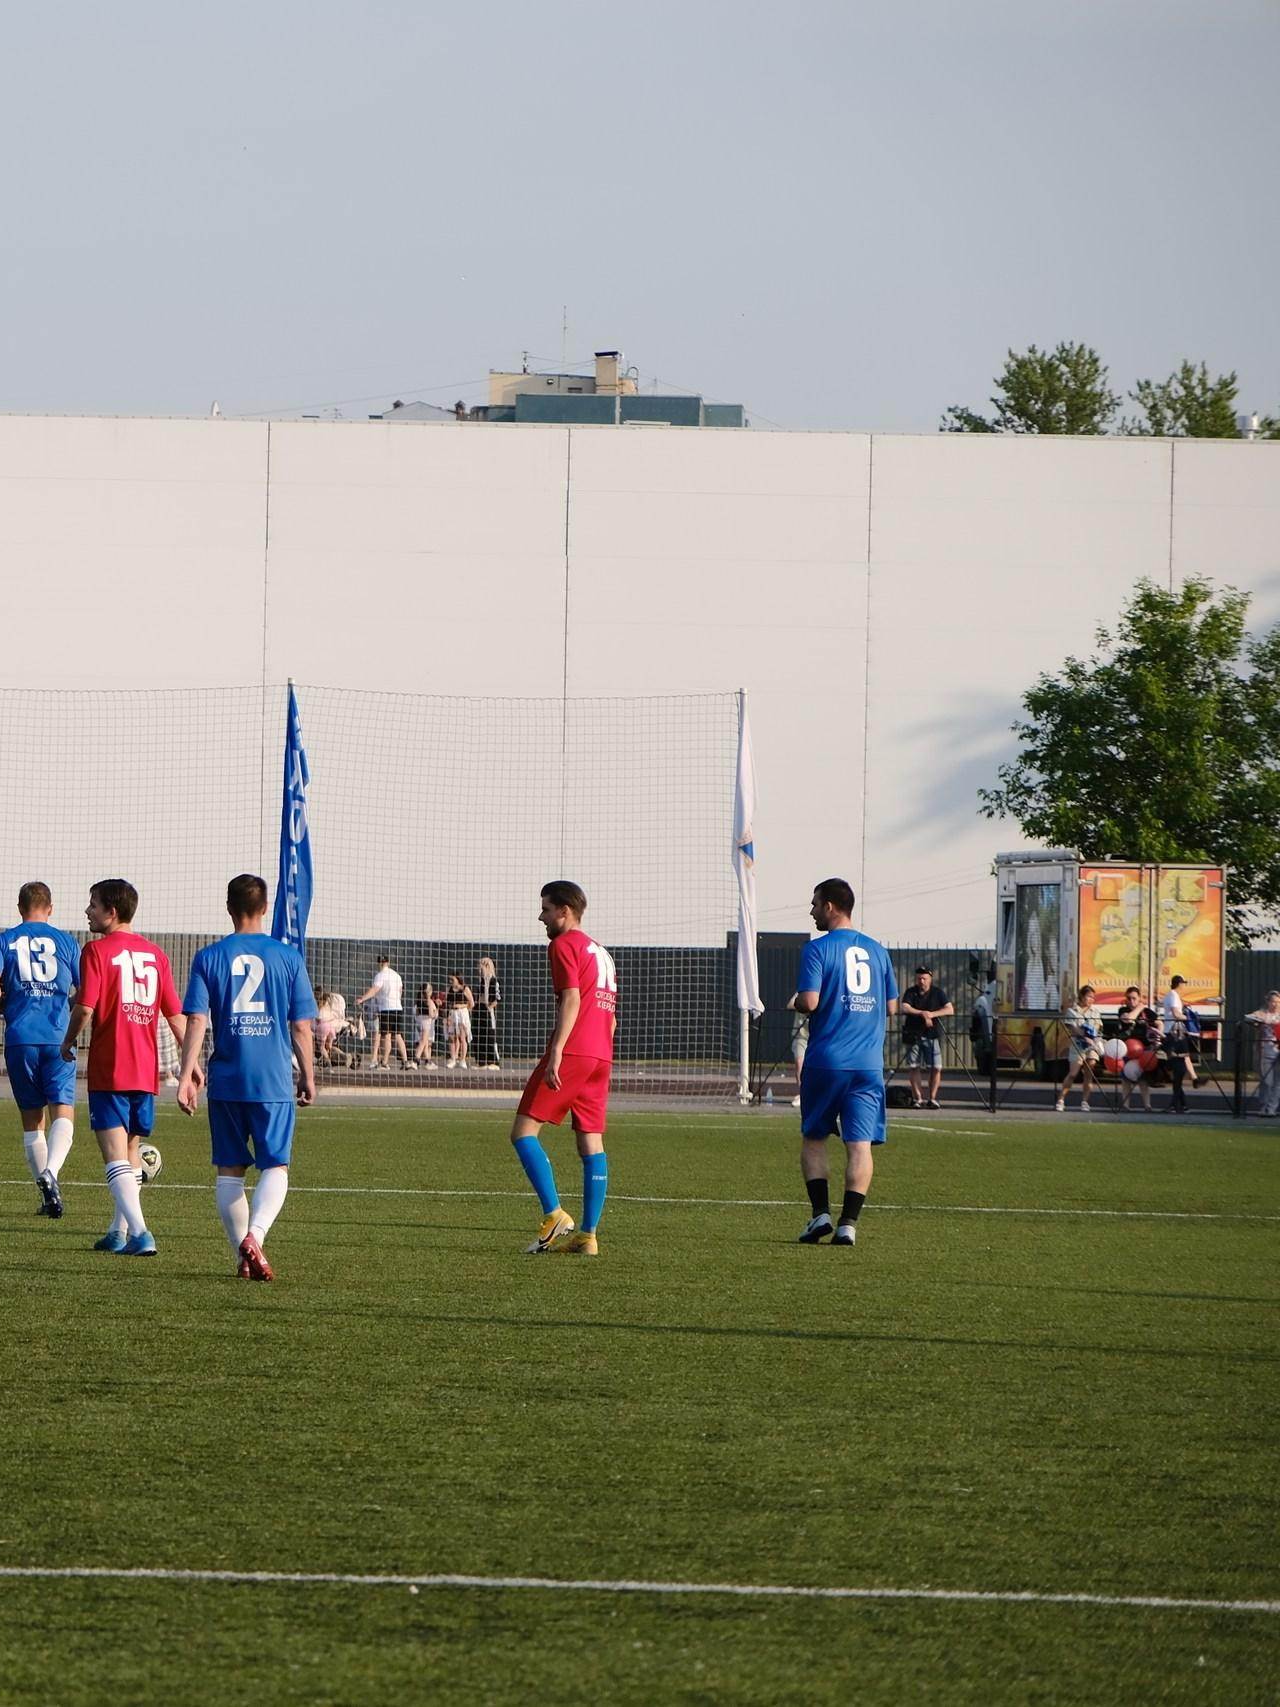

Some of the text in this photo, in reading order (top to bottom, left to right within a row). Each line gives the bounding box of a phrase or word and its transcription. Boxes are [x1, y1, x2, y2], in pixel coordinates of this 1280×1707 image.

[9, 935, 58, 983] 13
[112, 949, 158, 1007] 15
[845, 946, 871, 995] 6
[231, 954, 265, 1013] 2
[231, 1026, 272, 1037] К СЕРДЦУ
[239, 1015, 276, 1026] СЕРДЦА
